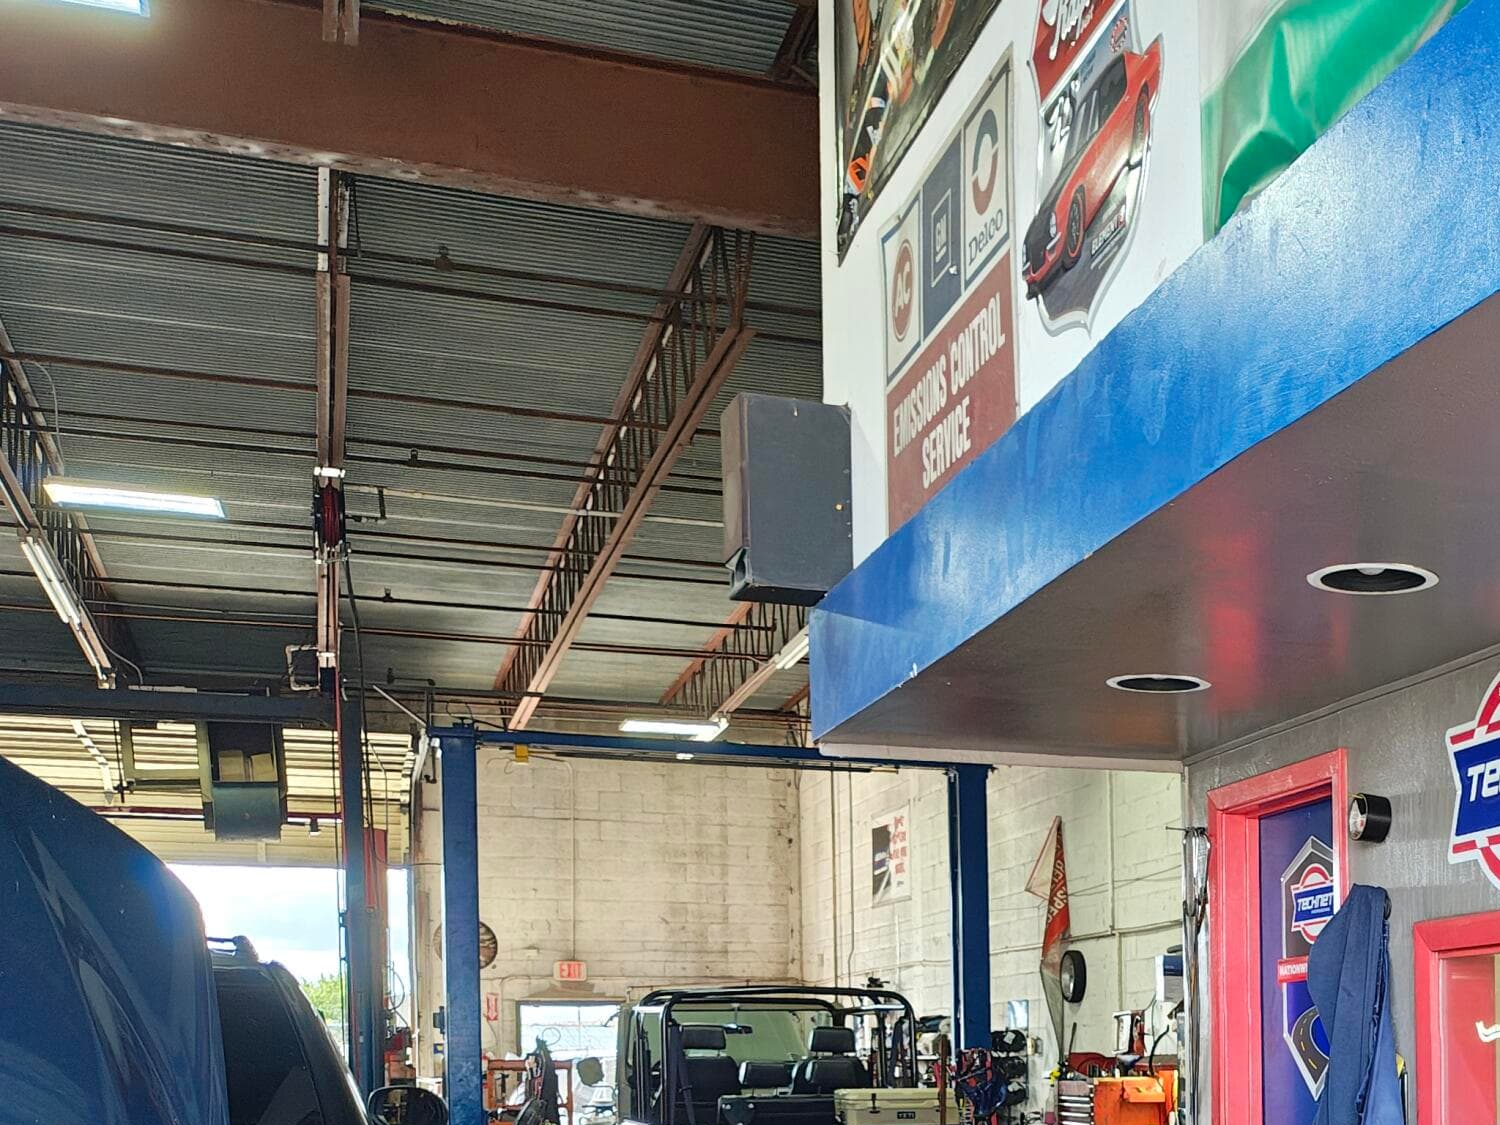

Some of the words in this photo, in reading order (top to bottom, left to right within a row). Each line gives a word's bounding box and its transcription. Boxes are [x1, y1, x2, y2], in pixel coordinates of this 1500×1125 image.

[969, 209, 1003, 266] Delco
[894, 260, 911, 318] AC
[893, 354, 947, 458] EMISSIONS
[950, 292, 1006, 396] CONTROL
[922, 395, 972, 490] SERVICE
[559, 963, 584, 979] EXIT
